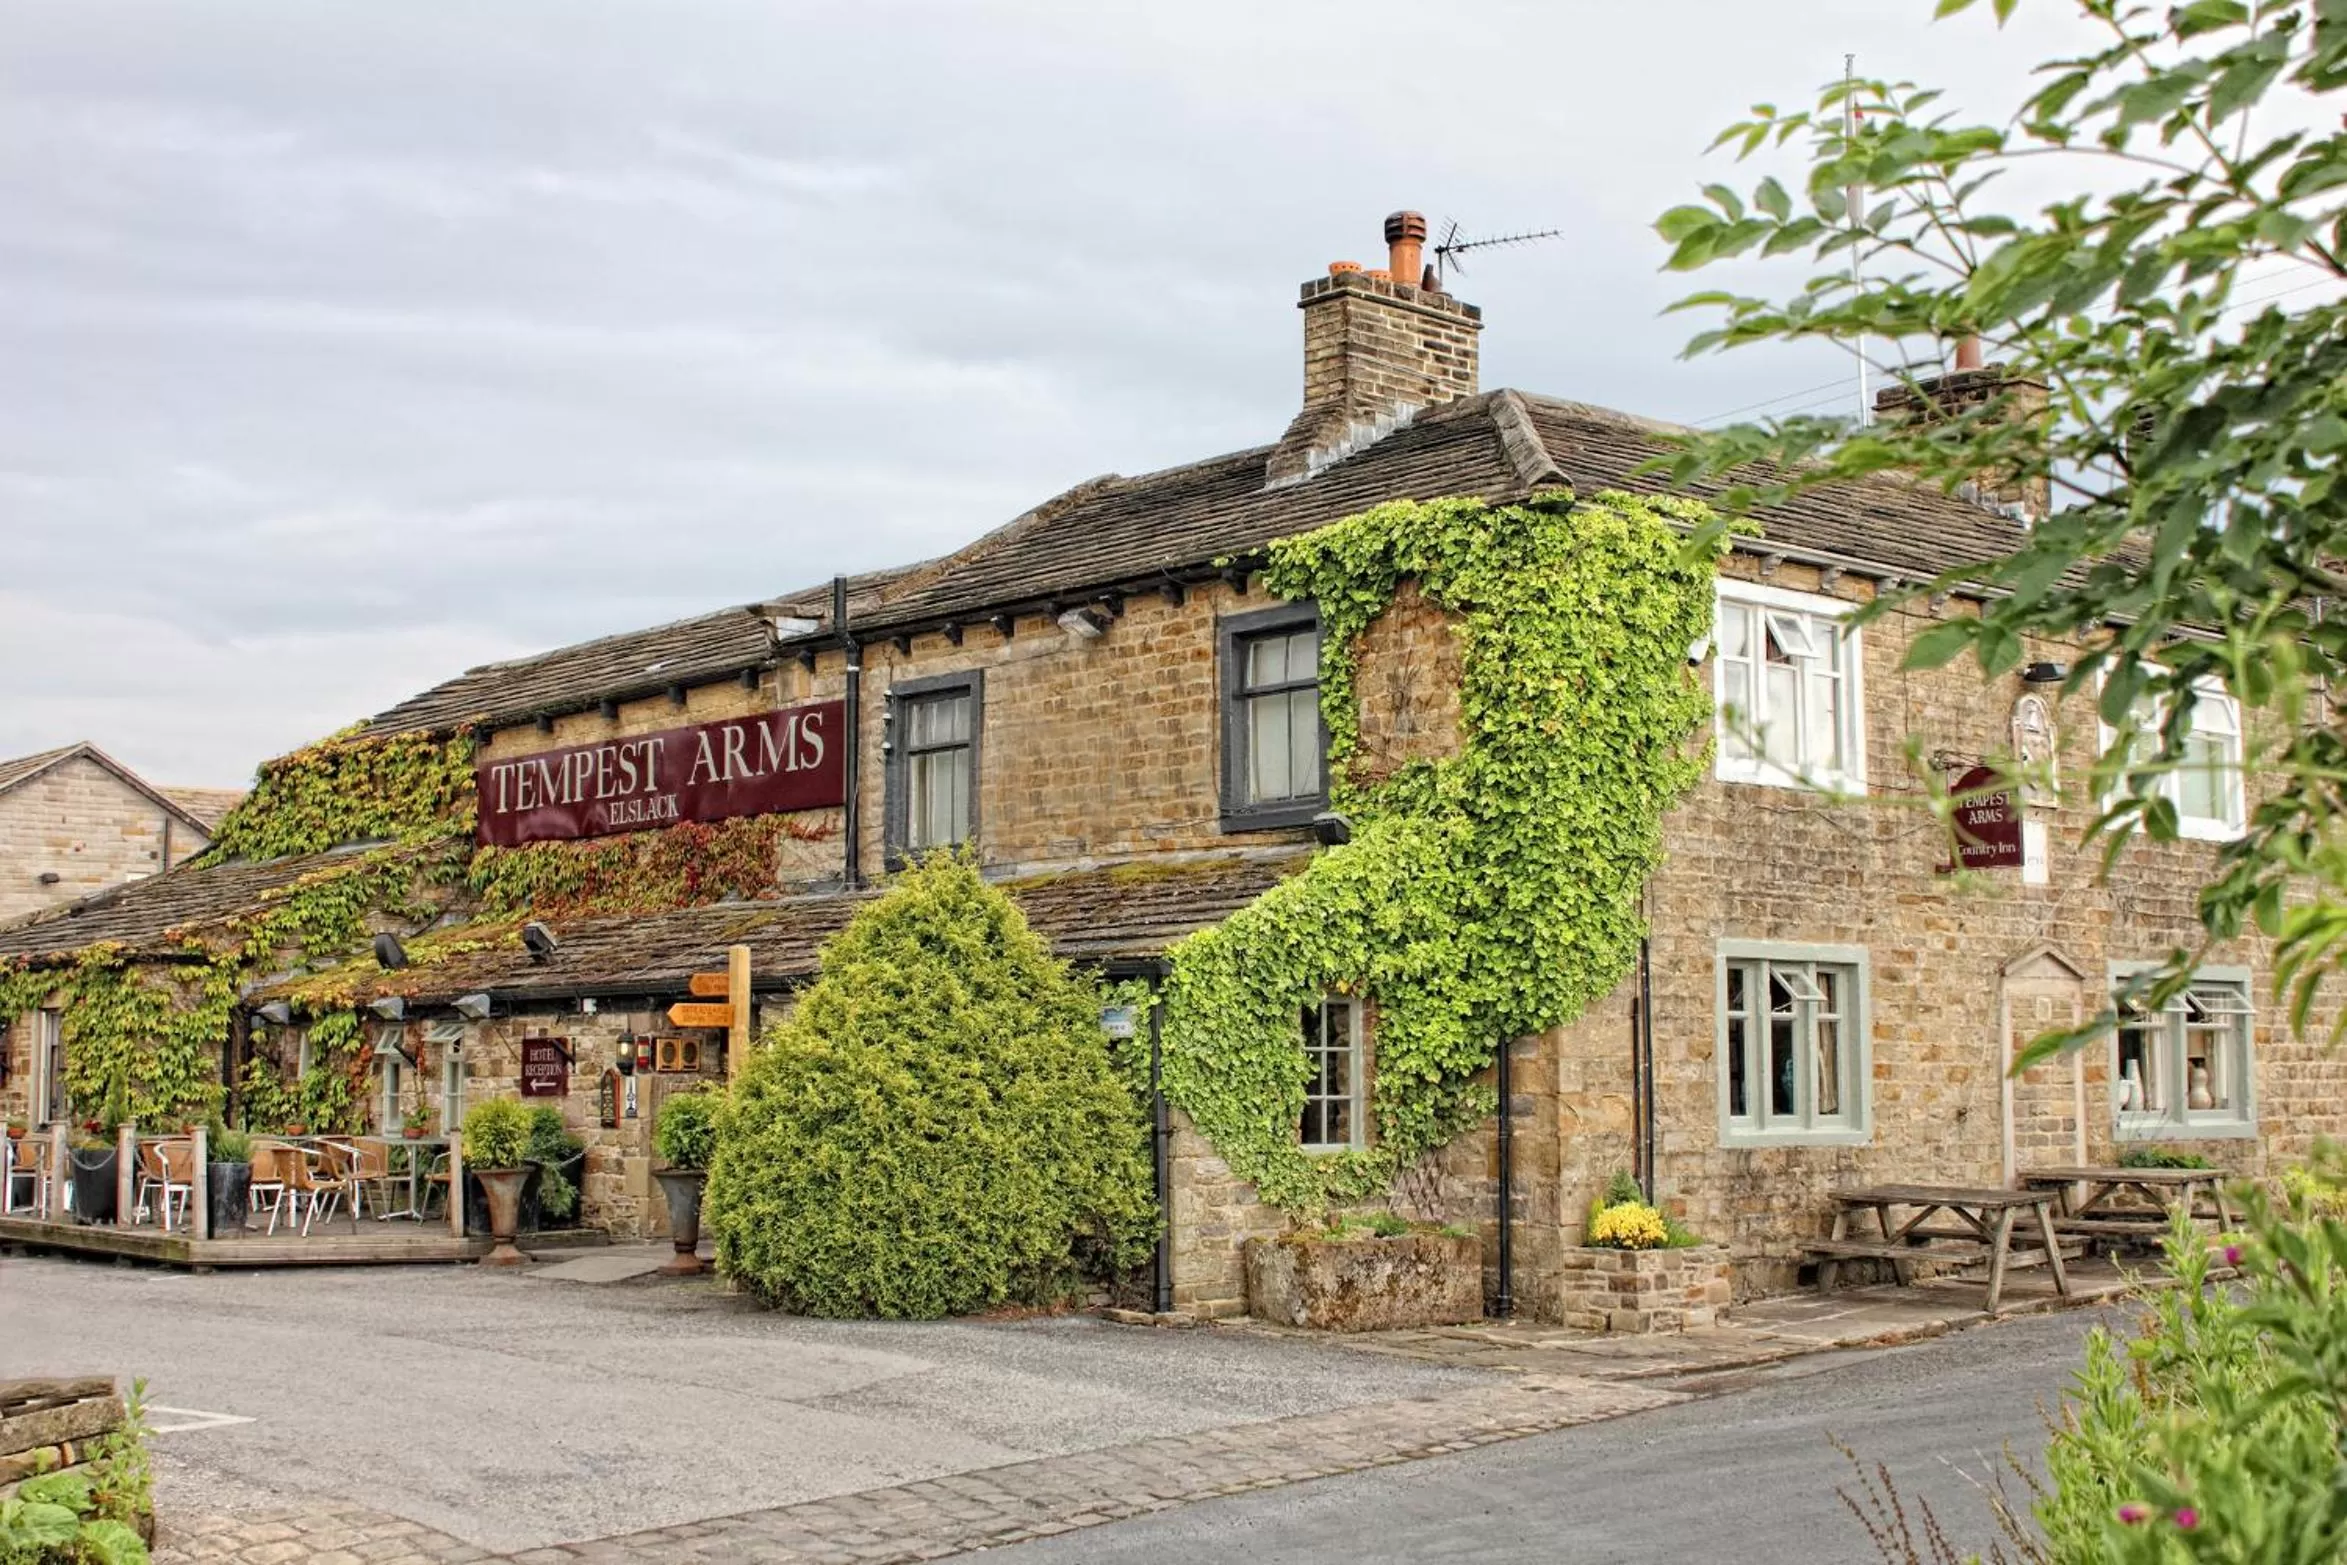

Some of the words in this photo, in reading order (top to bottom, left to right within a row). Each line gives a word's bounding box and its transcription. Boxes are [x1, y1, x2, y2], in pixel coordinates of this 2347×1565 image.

[491, 737, 665, 814] TEMPEST
[687, 711, 825, 786] ARMS
[608, 793, 680, 826] ELSLACK
[1968, 808, 2004, 825] ARMS
[1957, 842, 1997, 859] Country
[1998, 841, 2017, 854] Inn
[529, 1047, 556, 1062] HOTEL
[524, 1063, 563, 1077] RECEPTION
